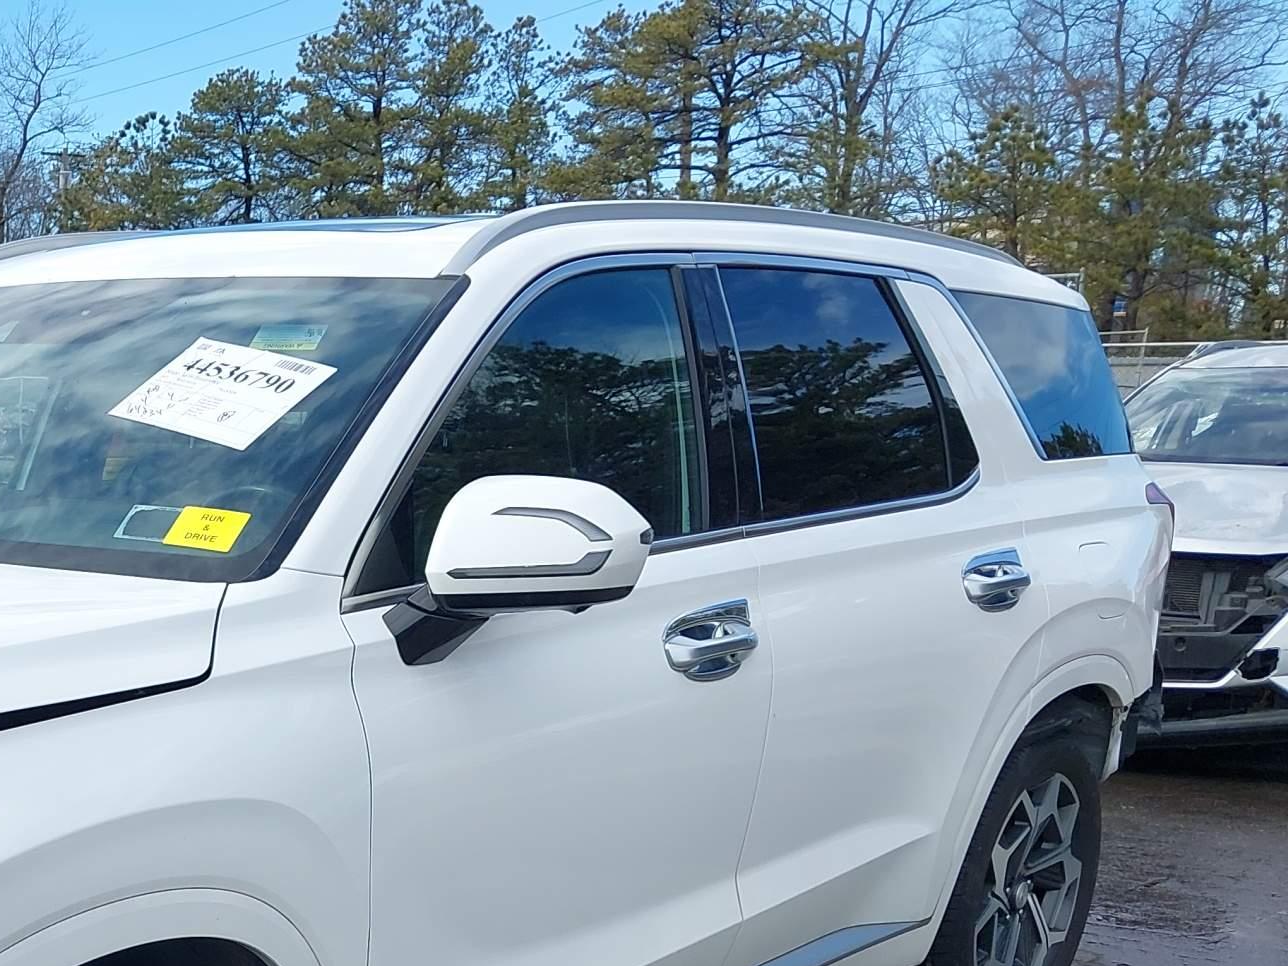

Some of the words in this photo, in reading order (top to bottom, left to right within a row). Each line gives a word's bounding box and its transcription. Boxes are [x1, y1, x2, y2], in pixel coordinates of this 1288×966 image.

[183, 358, 296, 394] 44536790
[200, 513, 226, 523] RUN
[202, 524, 210, 532] &
[184, 532, 218, 543] DRIVE
